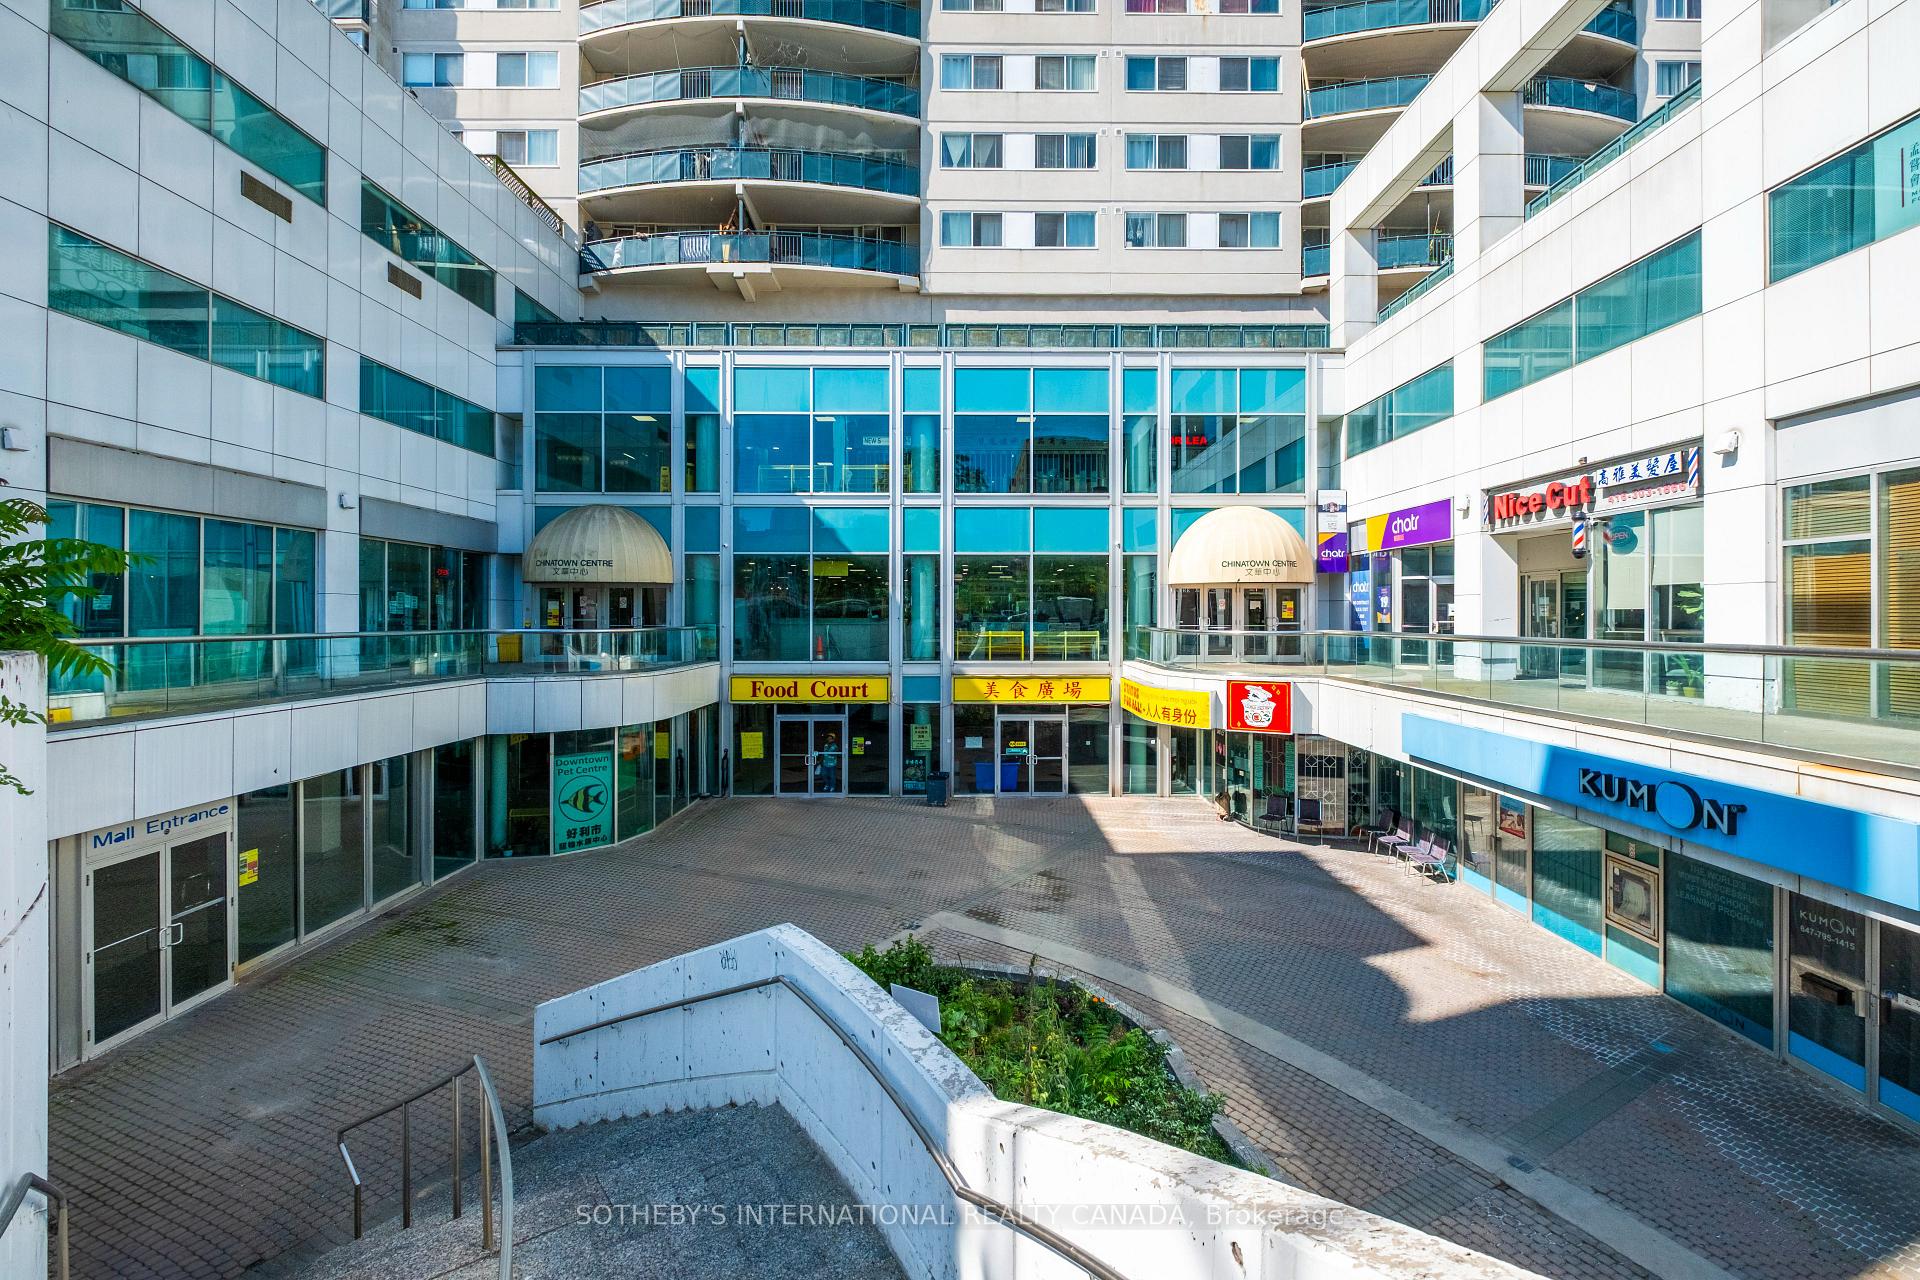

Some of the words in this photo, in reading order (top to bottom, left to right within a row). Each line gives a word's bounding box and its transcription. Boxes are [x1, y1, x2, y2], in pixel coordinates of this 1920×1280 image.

[1494, 491, 1543, 519] Nice
[1545, 476, 1591, 509] Cut
[1392, 513, 1420, 534] chatr
[1321, 549, 1346, 558] chatr
[536, 559, 578, 567] CHINATOWN
[580, 559, 613, 567] CENTRE
[1221, 559, 1270, 568] CHINATOWN
[1272, 559, 1297, 568] CENTRE
[750, 680, 799, 698] Food
[810, 680, 869, 698] Court
[983, 680, 1082, 699] 美食廣場
[1146, 703, 1197, 725] 人人有身份
[555, 755, 609, 767] Downtown
[557, 768, 574, 777] Pet
[576, 764, 608, 774] Centre
[1579, 768, 1738, 836] KUMON
[93, 826, 135, 849] Mall
[146, 804, 229, 835] Entrance
[566, 824, 602, 840] 好利市
[1800, 910, 1855, 937] KUMON
